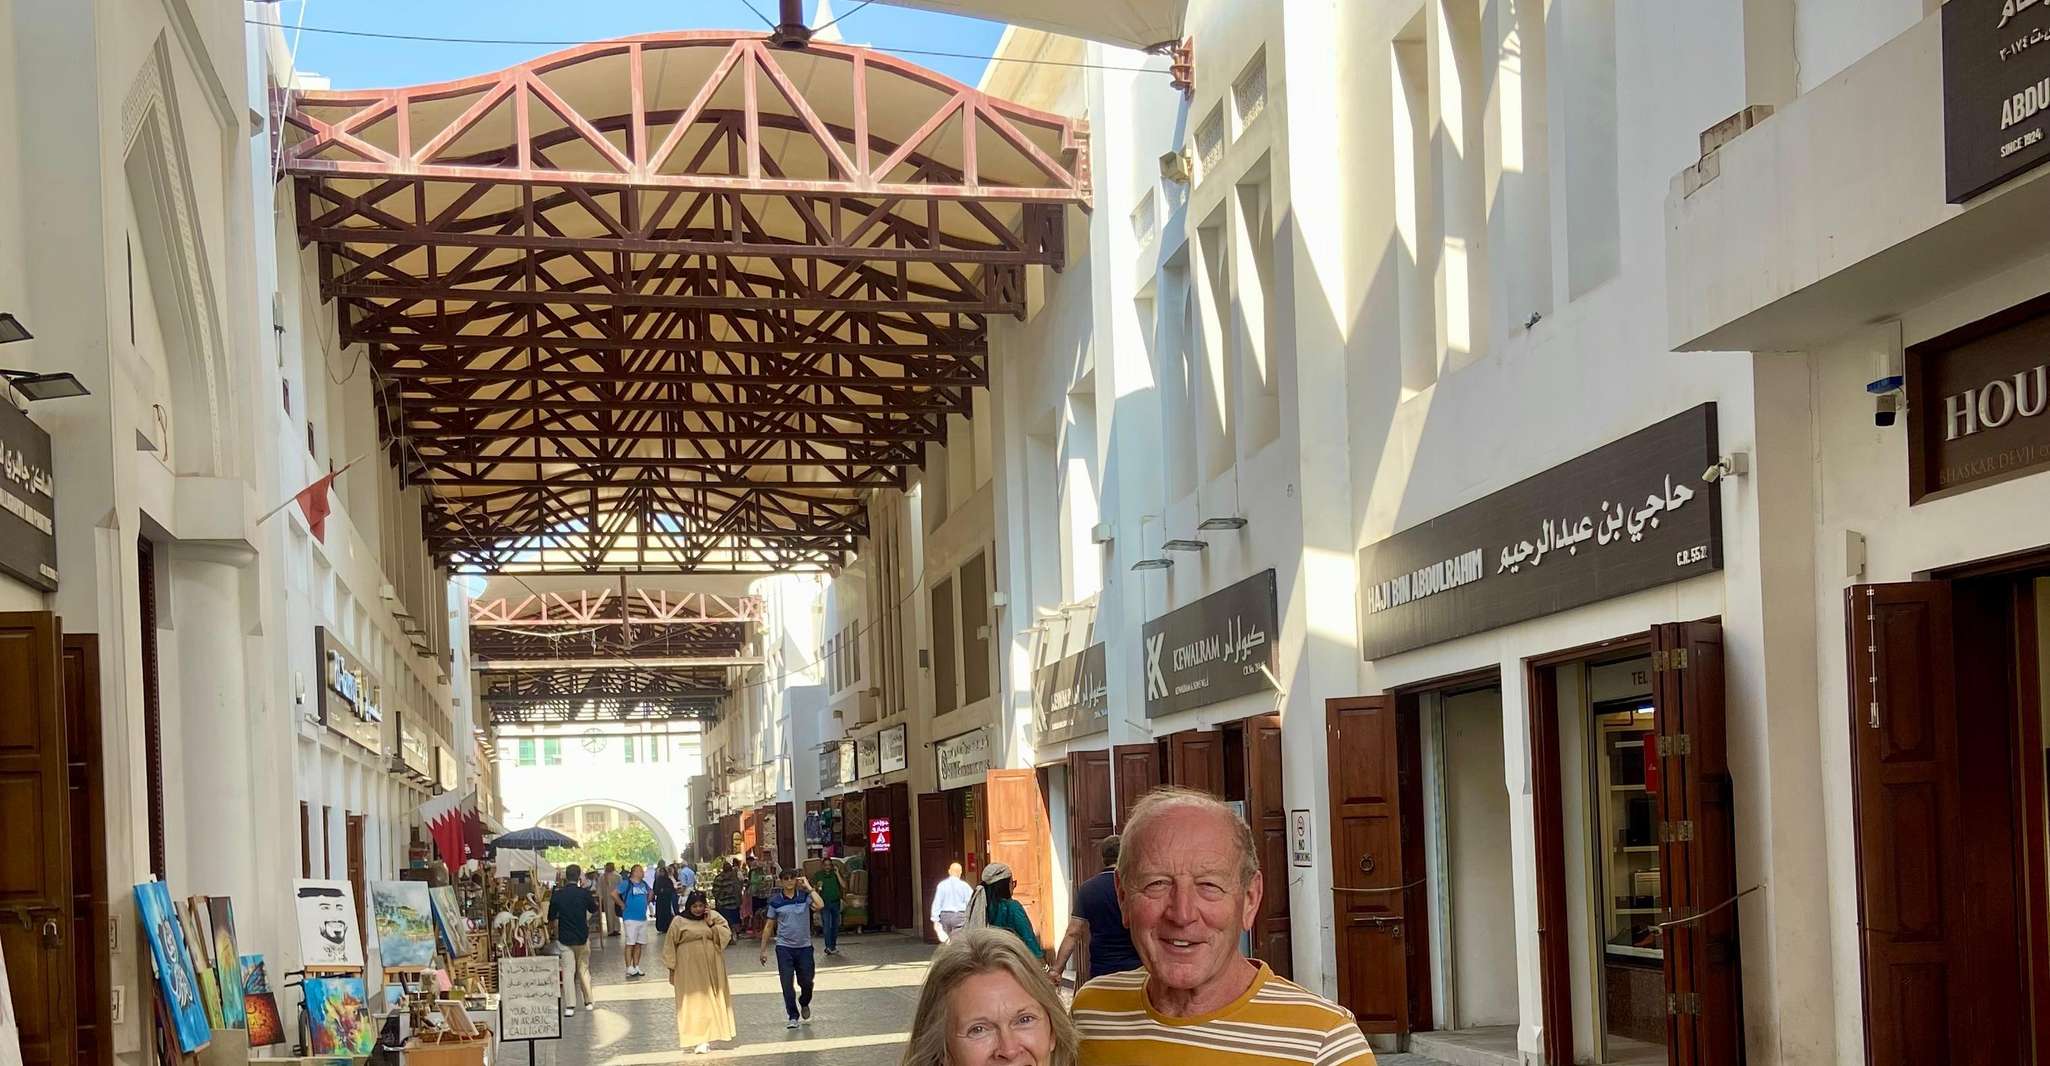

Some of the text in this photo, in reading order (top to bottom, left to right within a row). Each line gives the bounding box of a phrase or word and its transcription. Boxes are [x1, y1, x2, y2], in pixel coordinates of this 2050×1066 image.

[2001, 136, 2023, 158] SINCE
[1944, 365, 2048, 441] HOU
[1598, 500, 1624, 546] بن
[1627, 473, 1695, 543] حاجي
[1368, 548, 1483, 615] HAJI BIN ABDULRAHIM
[1173, 634, 1220, 672] KEWALRAM
[510, 1006, 528, 1017] YOUR
[511, 1015, 550, 1026] IN ARABIC
